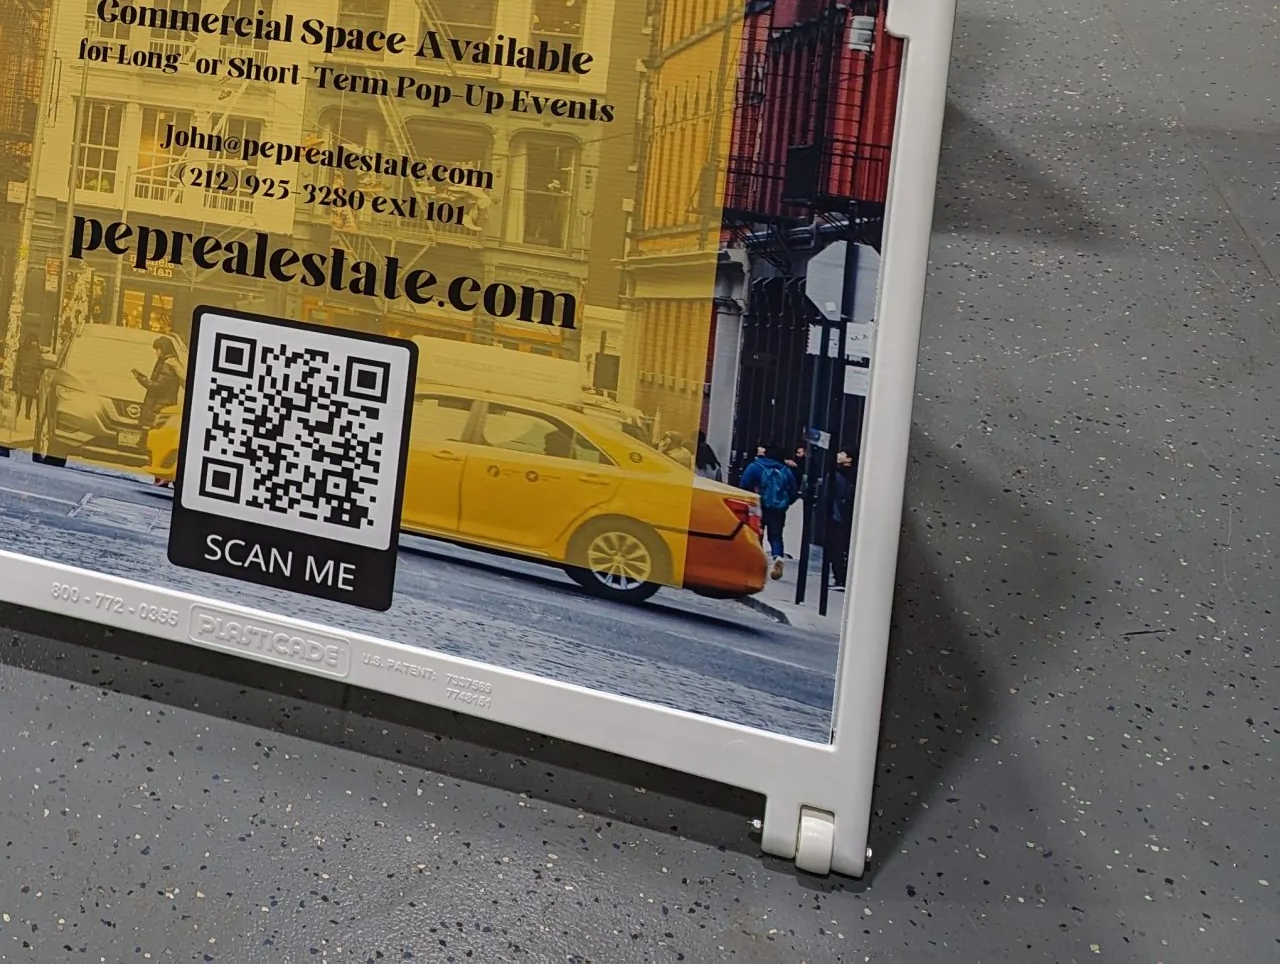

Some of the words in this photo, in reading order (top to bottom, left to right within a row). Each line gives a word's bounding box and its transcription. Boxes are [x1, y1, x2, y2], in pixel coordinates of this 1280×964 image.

[300, 17, 407, 55] Space
[414, 30, 594, 75] Available
[78, 37, 114, 62] for
[195, 57, 223, 76] or
[228, 57, 389, 98] Short-Term
[396, 74, 505, 113] Pop-Up
[510, 89, 616, 124] Events
[159, 123, 494, 190] John@peprealestate.com
[180, 164, 239, 194] (212)
[245, 174, 365, 213] 925-3280
[371, 194, 417, 220] ext
[425, 200, 465, 226] 101
[69, 214, 578, 330] peprealestate.com
[204, 533, 292, 579] SCAN
[304, 556, 356, 591] ME
[95, 591, 125, 614] 772
[139, 602, 180, 627] 0355
[198, 613, 339, 667] PLASTICADE
[362, 652, 384, 669] U.S.
[386, 658, 437, 682] PATENT:
